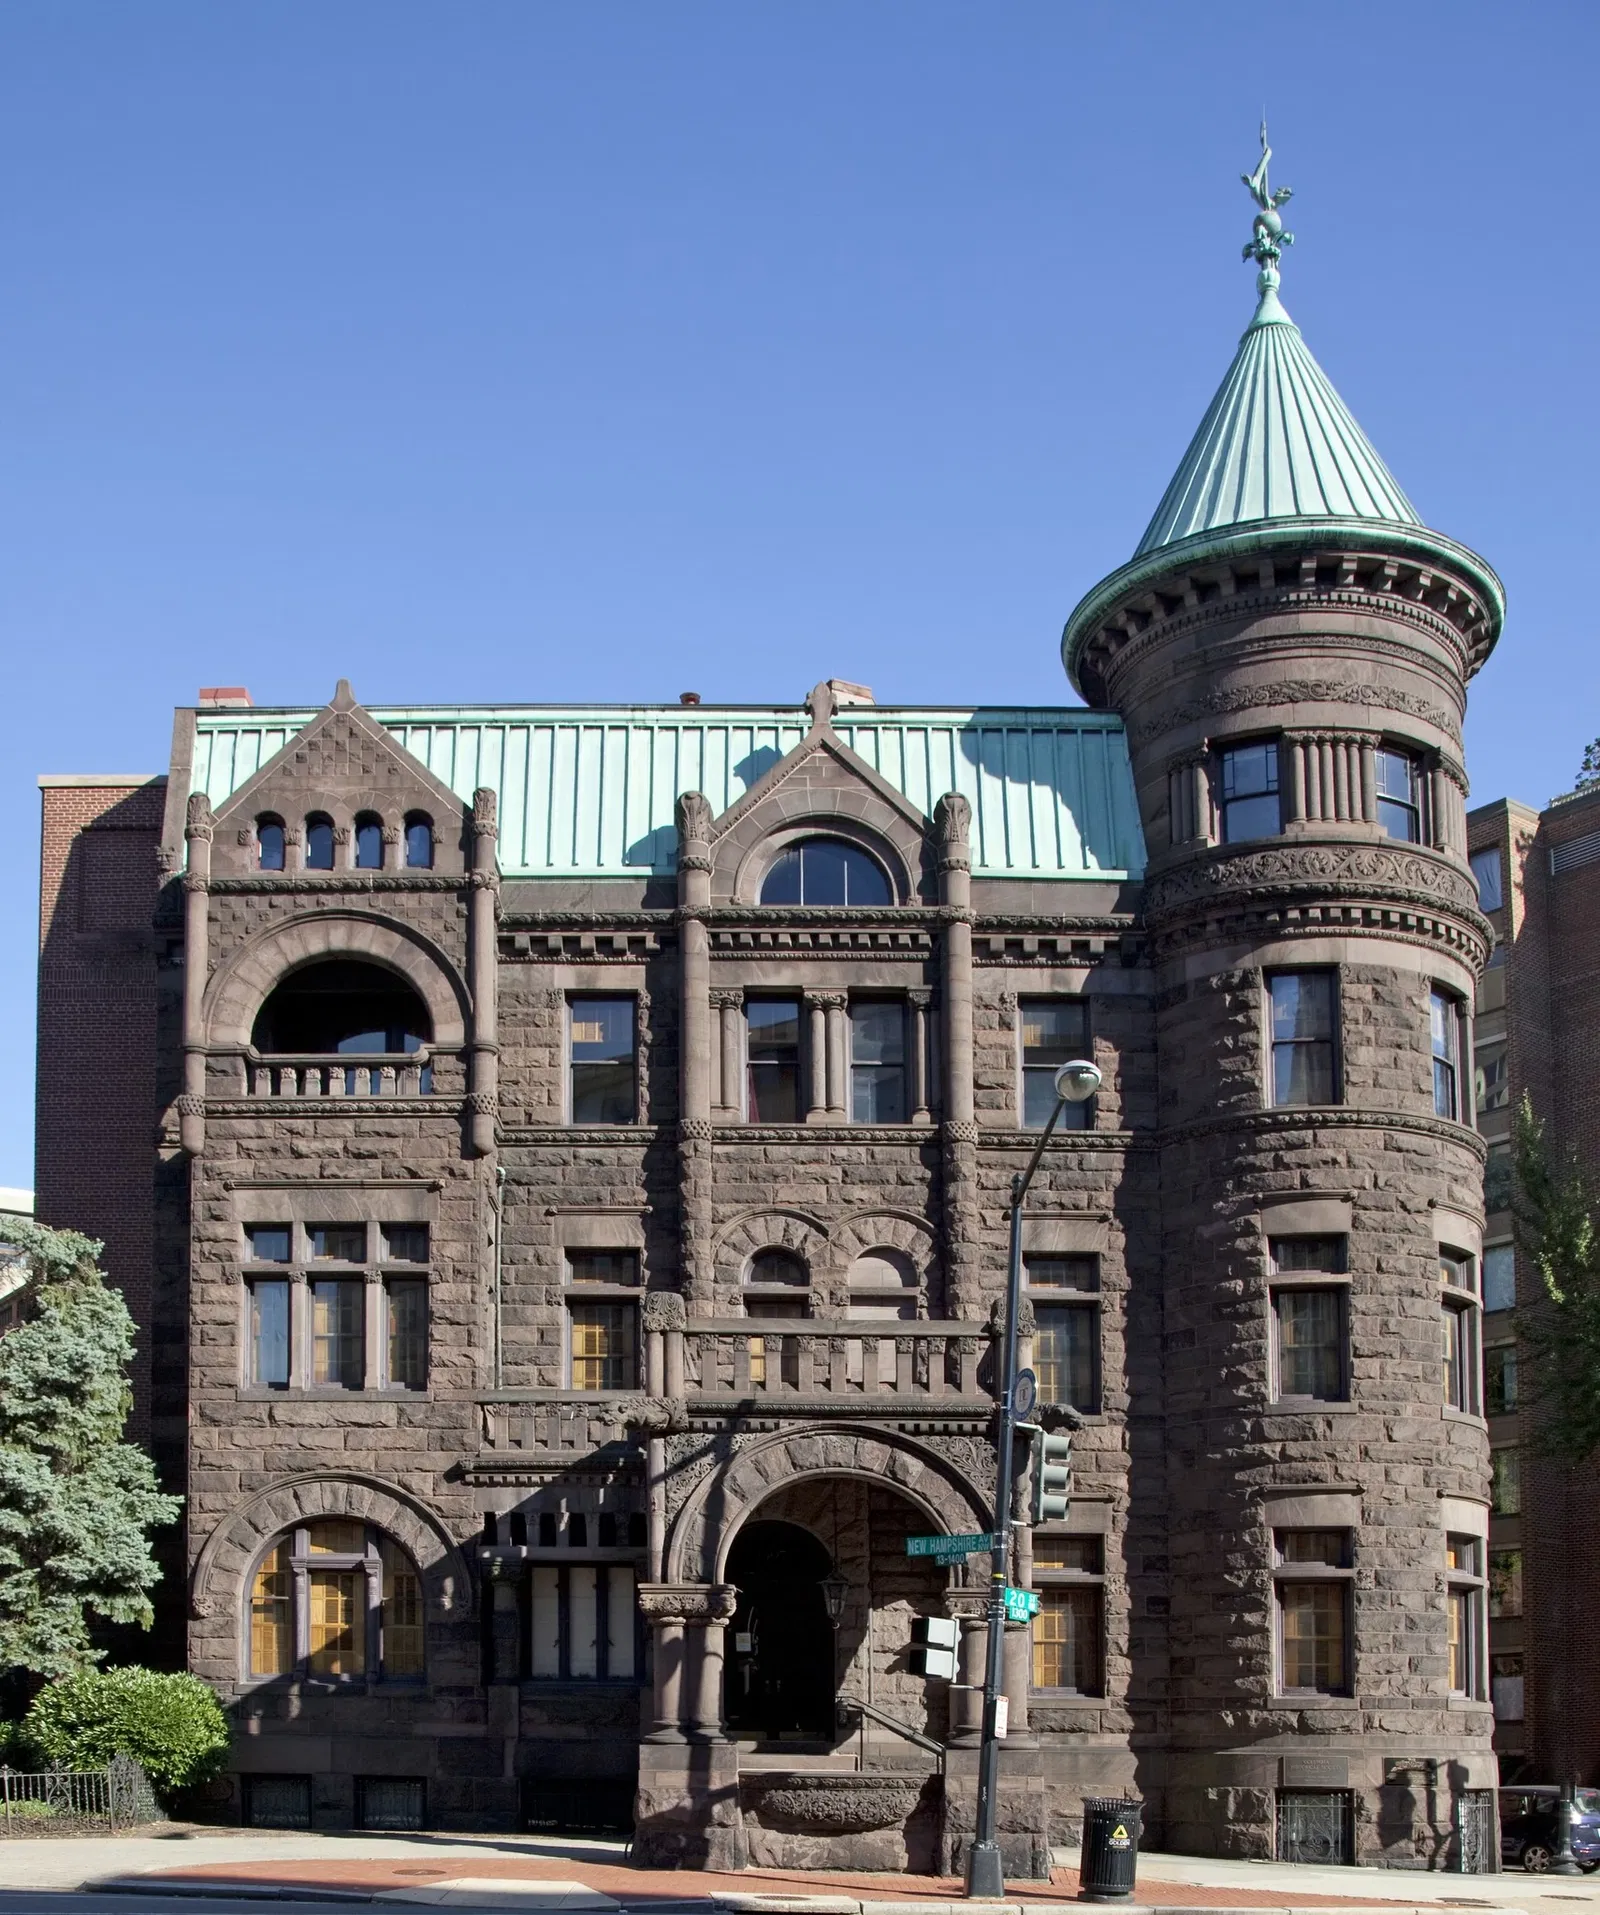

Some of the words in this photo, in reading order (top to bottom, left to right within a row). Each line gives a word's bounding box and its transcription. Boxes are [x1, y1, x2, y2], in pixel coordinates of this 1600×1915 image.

[907, 1540, 927, 1554] NEW
[930, 1536, 976, 1553] HAMPSHIRE
[936, 1554, 965, 1565] 13-1400
[1010, 1590, 1025, 1608] 20
[1011, 1607, 1028, 1619] 1300
